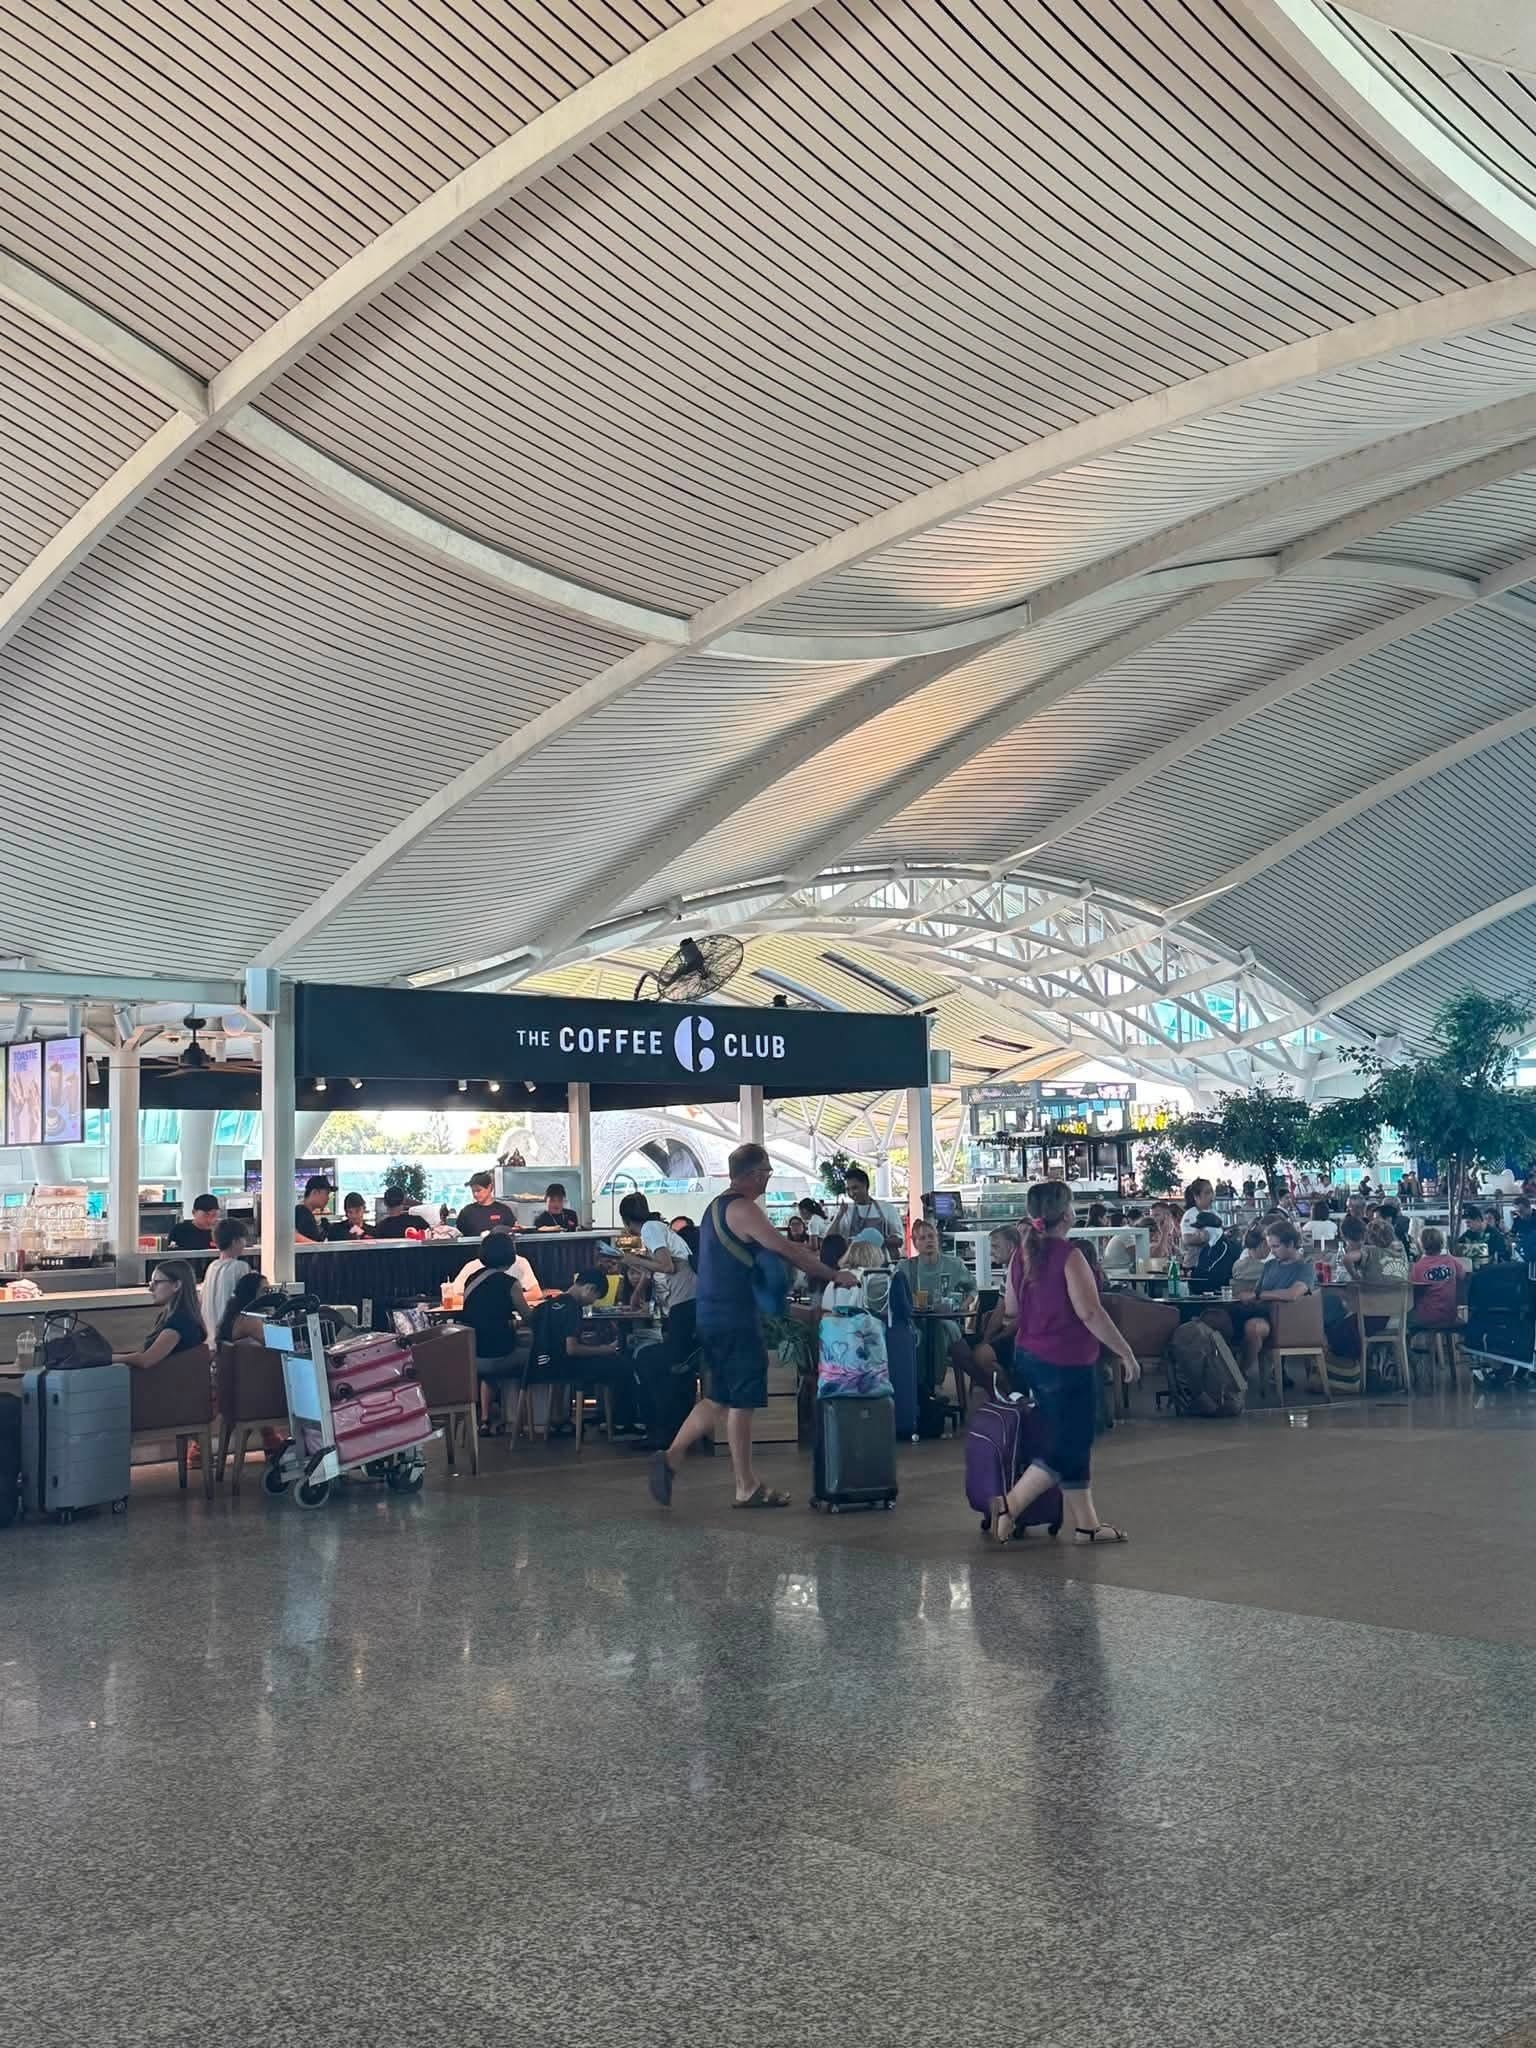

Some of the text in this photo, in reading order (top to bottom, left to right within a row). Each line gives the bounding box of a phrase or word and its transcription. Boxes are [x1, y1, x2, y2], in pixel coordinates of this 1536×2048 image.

[516, 1029, 550, 1047] THE
[559, 1026, 663, 1055] COFFEE
[724, 1033, 786, 1059] CLUB
